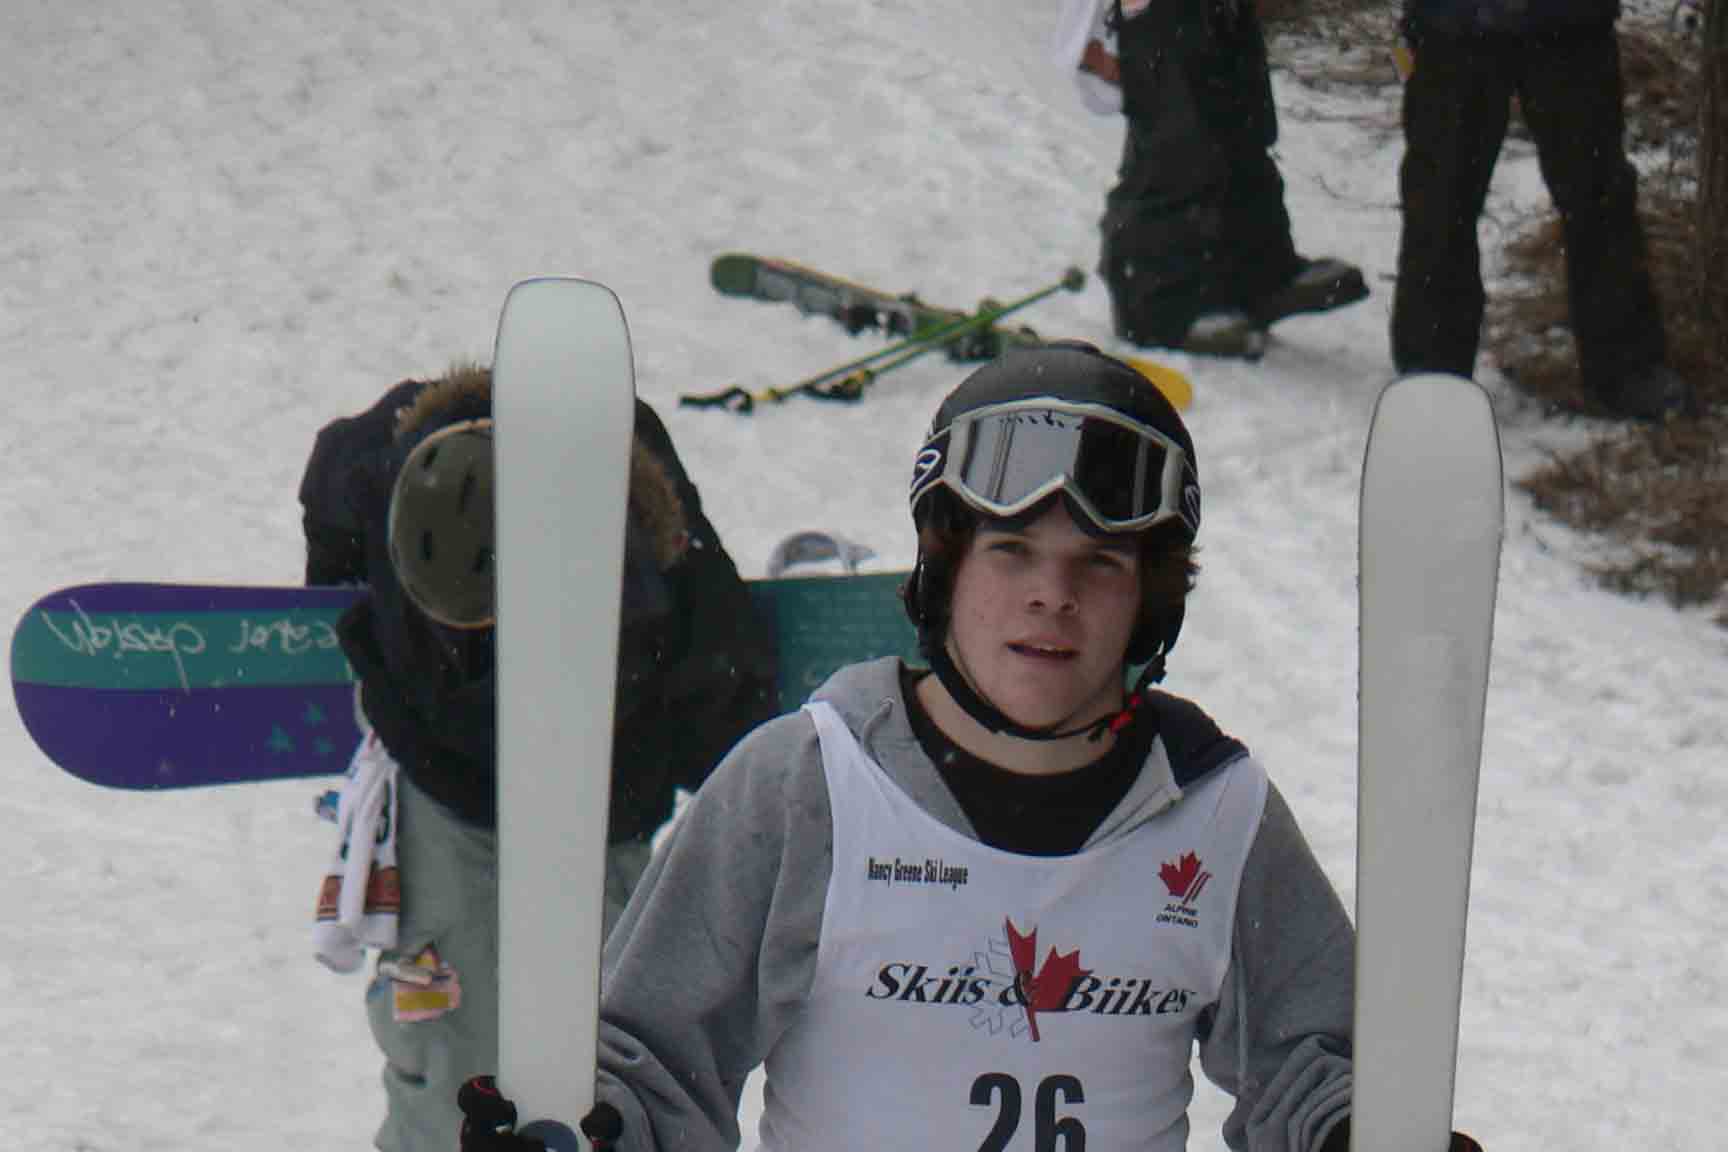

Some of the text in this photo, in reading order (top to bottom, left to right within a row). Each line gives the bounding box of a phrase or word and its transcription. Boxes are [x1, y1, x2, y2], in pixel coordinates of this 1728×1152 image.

[867, 857, 968, 891] Nancy Greene Ski League
[865, 962, 1197, 1016] Skiis & Biikes
